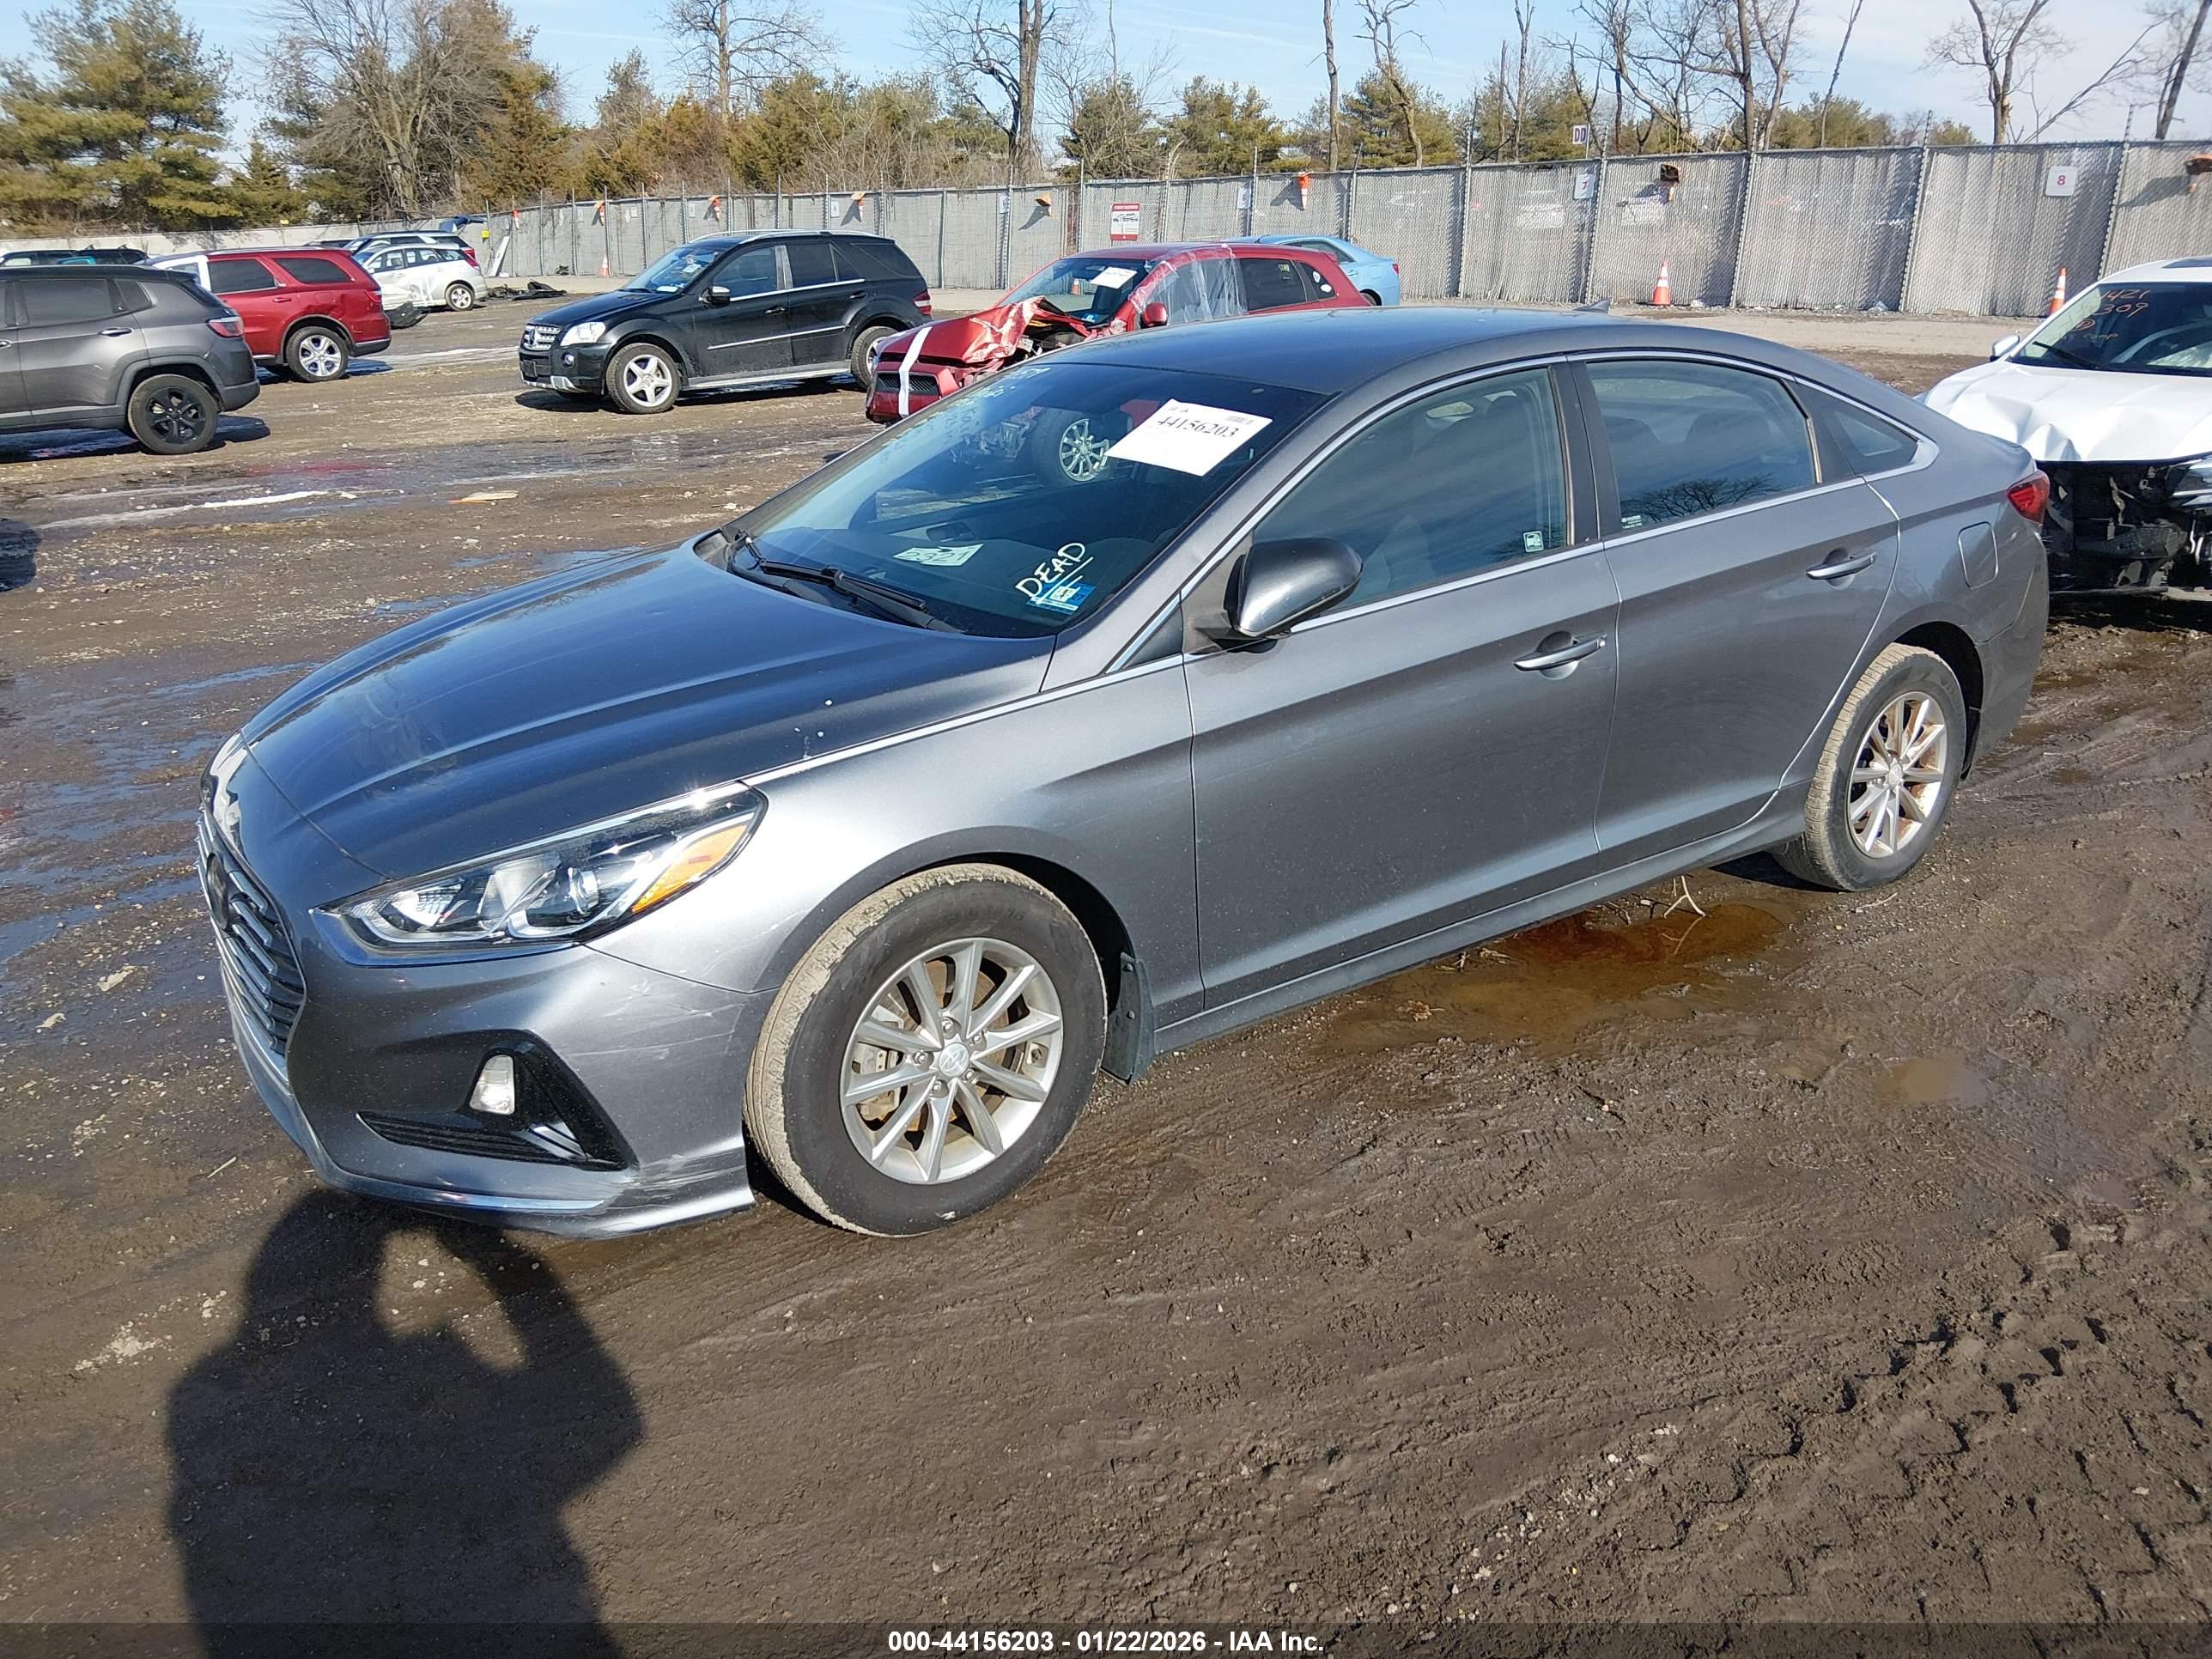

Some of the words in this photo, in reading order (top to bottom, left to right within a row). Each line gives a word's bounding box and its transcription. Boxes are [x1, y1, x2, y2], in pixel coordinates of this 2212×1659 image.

[1574, 127, 1587, 143] DD
[1582, 180, 1588, 191] 7
[2057, 174, 2066, 185] 8
[2093, 301, 2148, 319] 309
[1157, 416, 1239, 438] 44156203
[1015, 542, 1085, 598] DEAD
